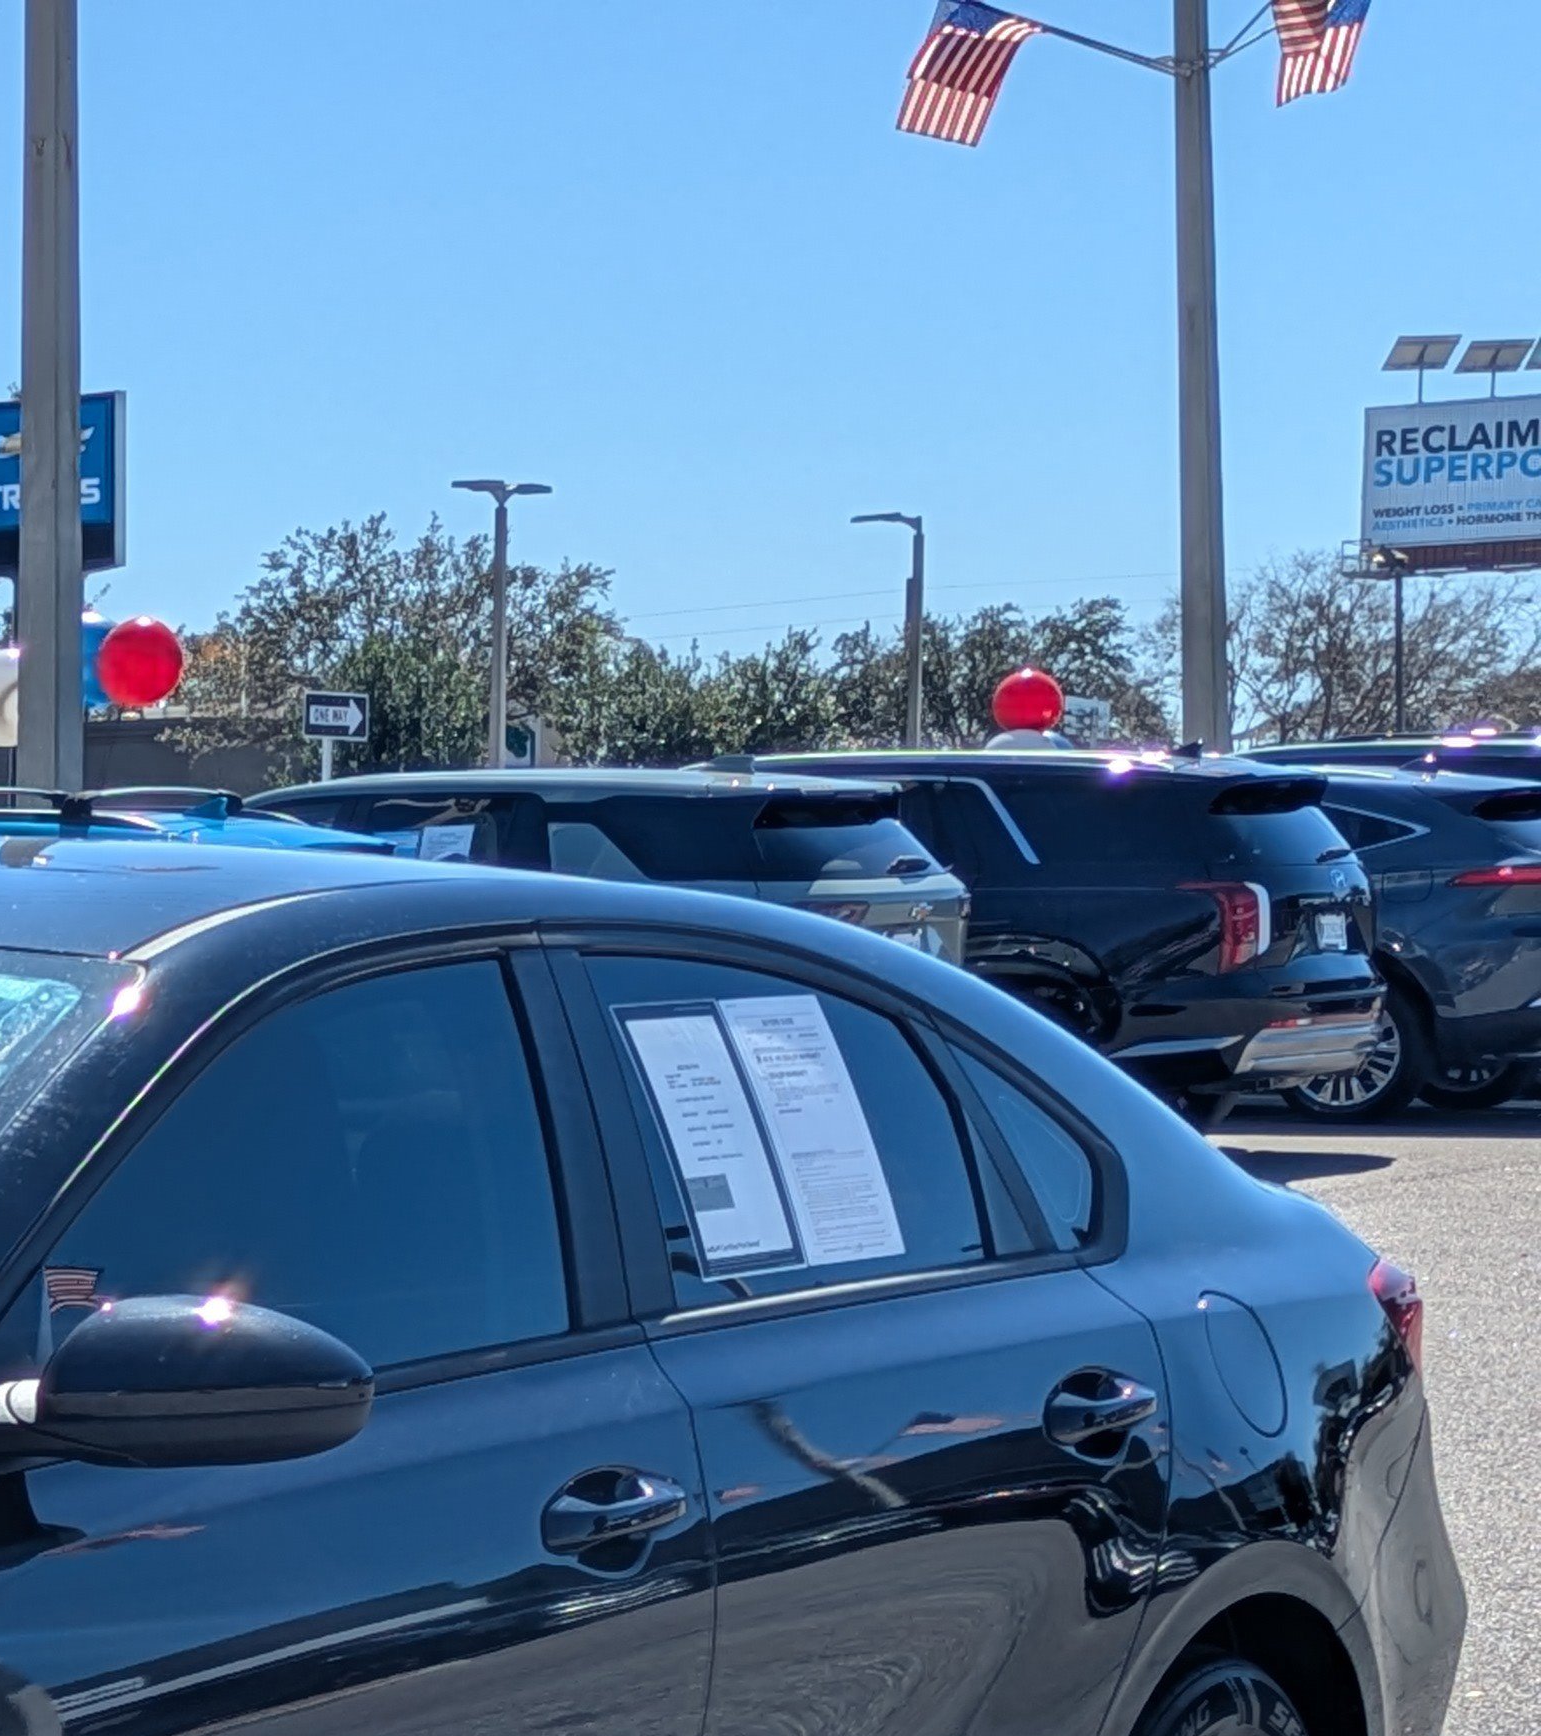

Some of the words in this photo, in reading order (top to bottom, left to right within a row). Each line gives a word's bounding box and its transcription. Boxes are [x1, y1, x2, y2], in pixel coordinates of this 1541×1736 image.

[1375, 418, 1540, 457] RECLAIM
[1373, 506, 1421, 518] WEIGHT
[1424, 504, 1454, 516] LOSS
[1372, 517, 1444, 531] AESTHETICS
[1457, 512, 1522, 525] HORMONE
[313, 707, 329, 723] ONE
[332, 708, 348, 723] WAY
